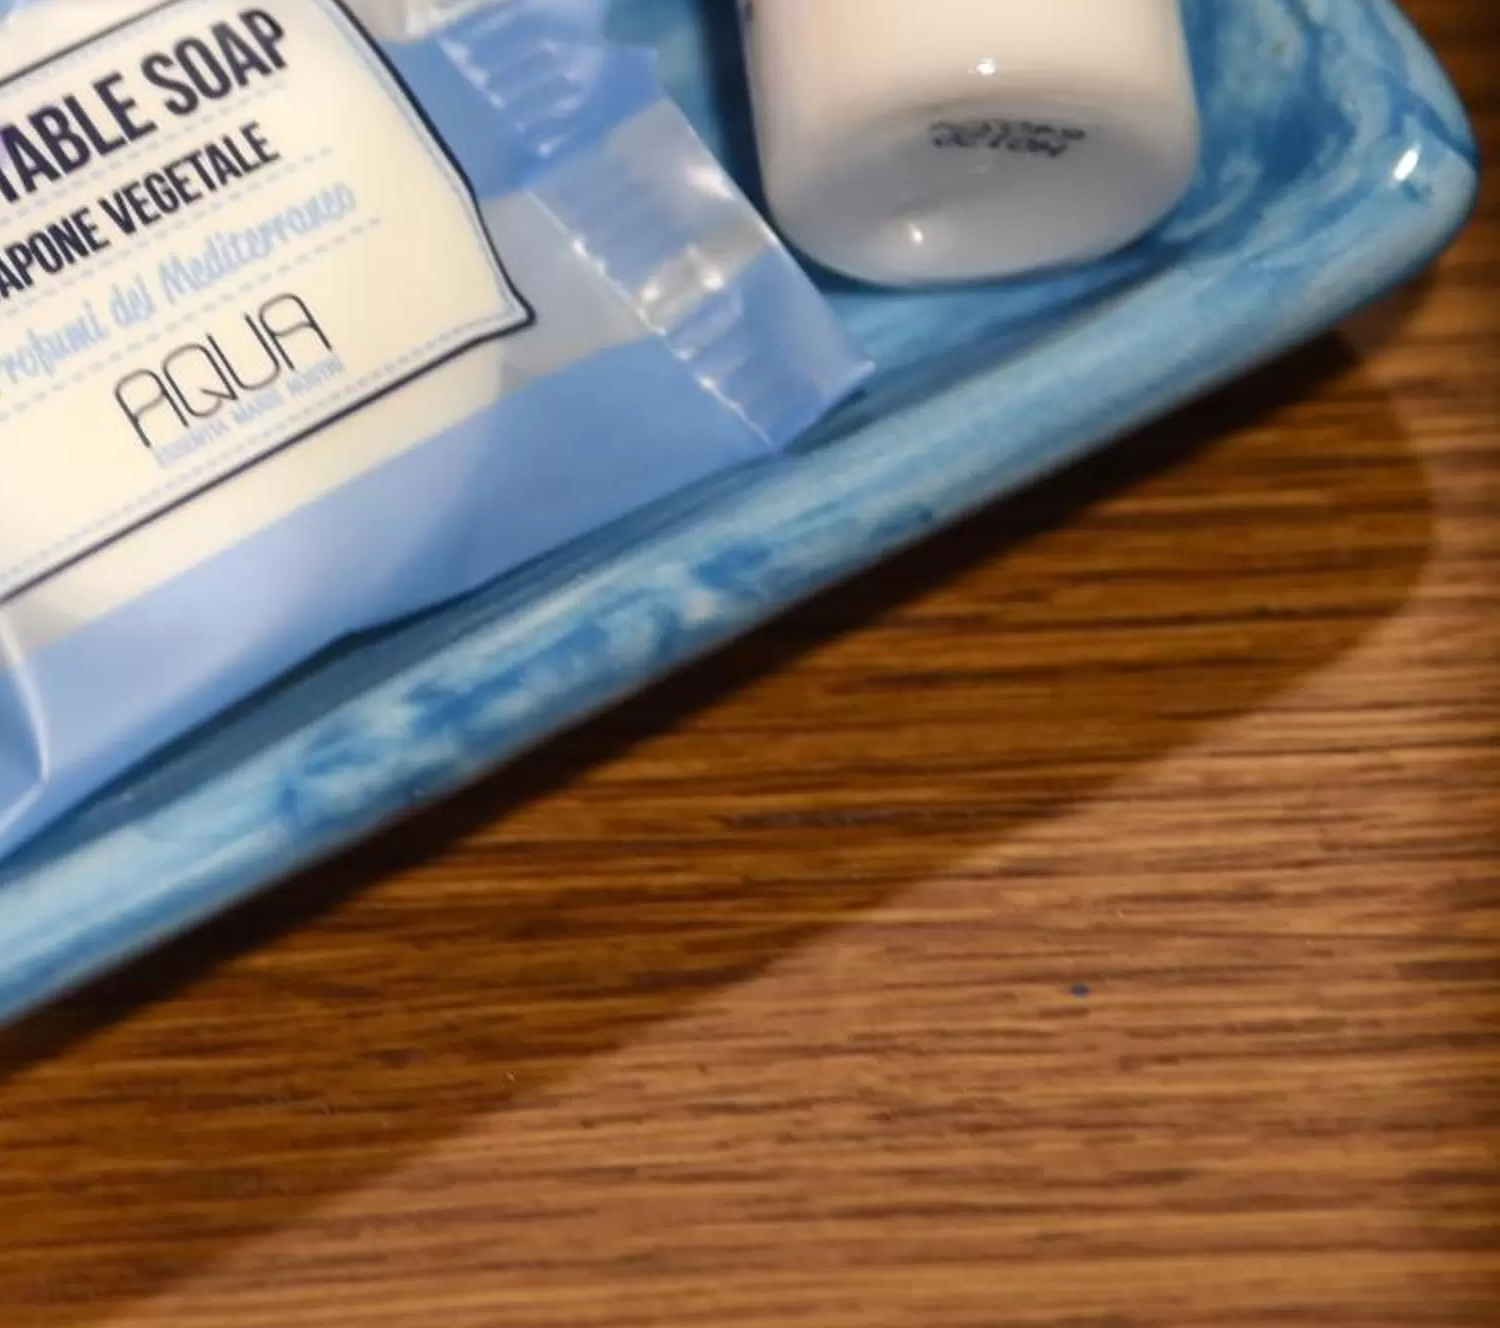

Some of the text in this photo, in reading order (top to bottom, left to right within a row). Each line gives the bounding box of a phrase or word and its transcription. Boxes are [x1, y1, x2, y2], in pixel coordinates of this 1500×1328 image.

[140, 8, 288, 117] SOAP
[98, 120, 282, 235] VEGETALE
[109, 274, 158, 329] del
[156, 180, 358, 306] Mediterraneo
[113, 292, 333, 449] AQUA
